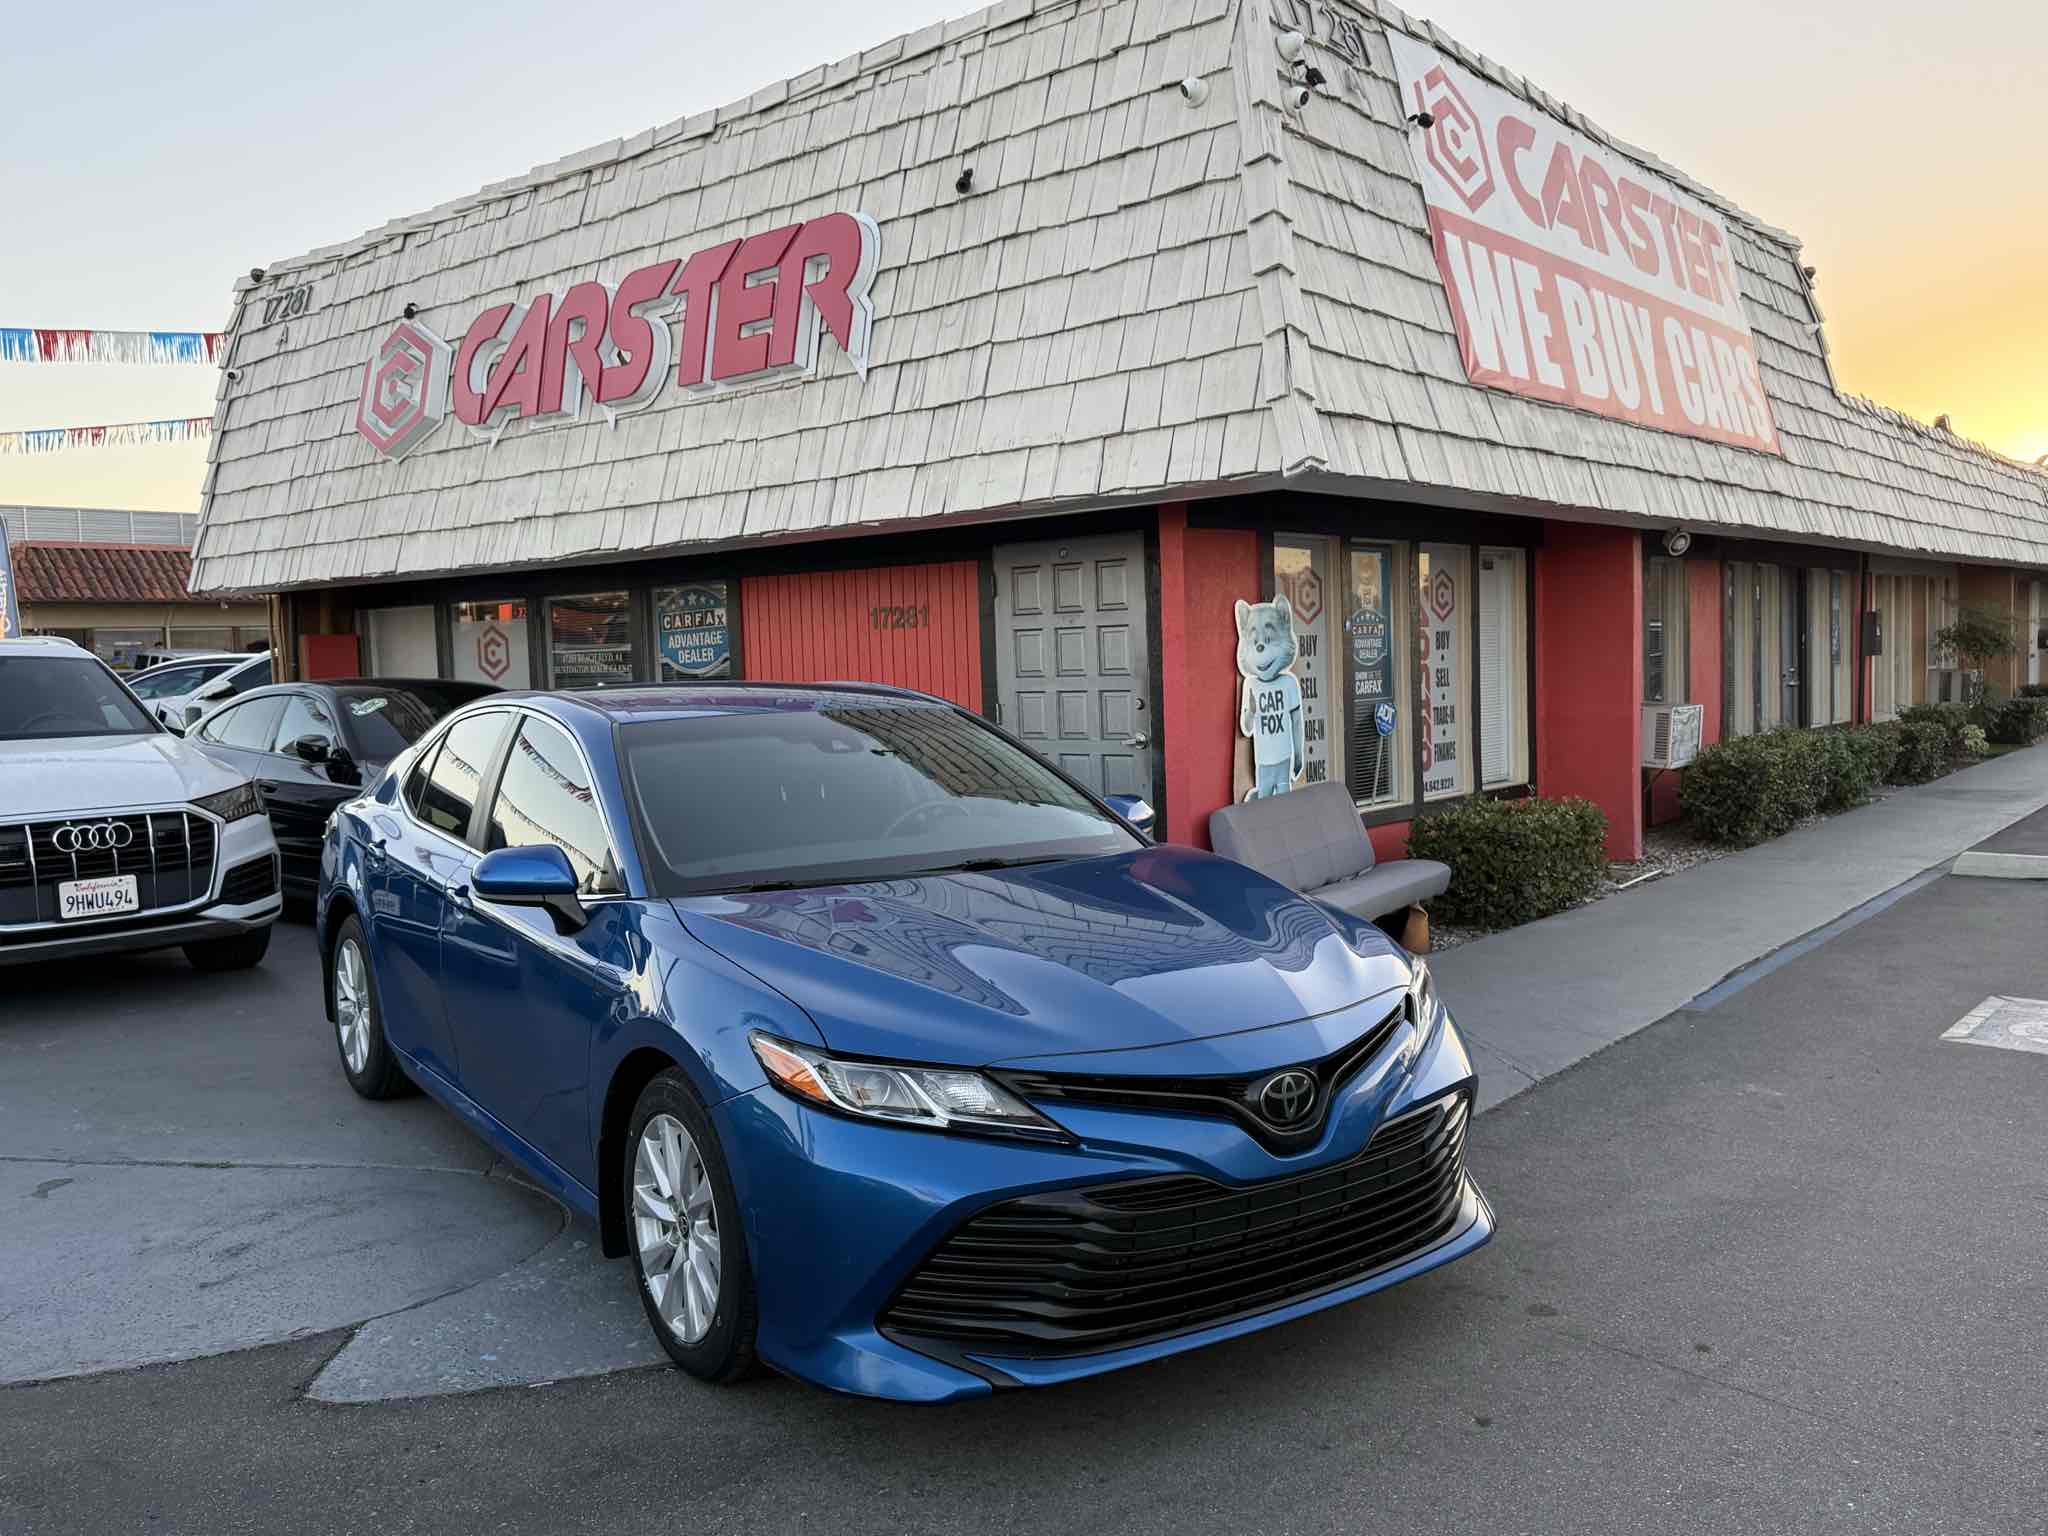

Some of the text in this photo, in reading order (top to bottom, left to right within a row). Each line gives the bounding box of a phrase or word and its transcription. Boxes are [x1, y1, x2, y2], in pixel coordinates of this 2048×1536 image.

[1496, 115, 1738, 307] CARSTER
[263, 285, 313, 324] 17281
[452, 211, 872, 428] CARSTER
[1439, 230, 1774, 444] WE BUY CARS
[663, 608, 727, 631] CARFAX
[870, 607, 928, 629] 17281
[668, 631, 723, 649] ADVANTAGE
[1299, 634, 1318, 657] BUY
[1436, 631, 1450, 650] BUY
[678, 648, 714, 664] DEALER
[1300, 677, 1318, 699] SELL
[1355, 680, 1383, 695] CARFAX
[1436, 667, 1450, 688] SELL
[1259, 690, 1284, 714] CAR
[1376, 703, 1395, 722] ADT
[1261, 712, 1285, 736] FOX
[1433, 704, 1455, 726] TRADE-IN
[1304, 719, 1325, 742] ADE-IN
[1434, 740, 1456, 763] FINANCE
[66, 889, 132, 913] 9HWU494
